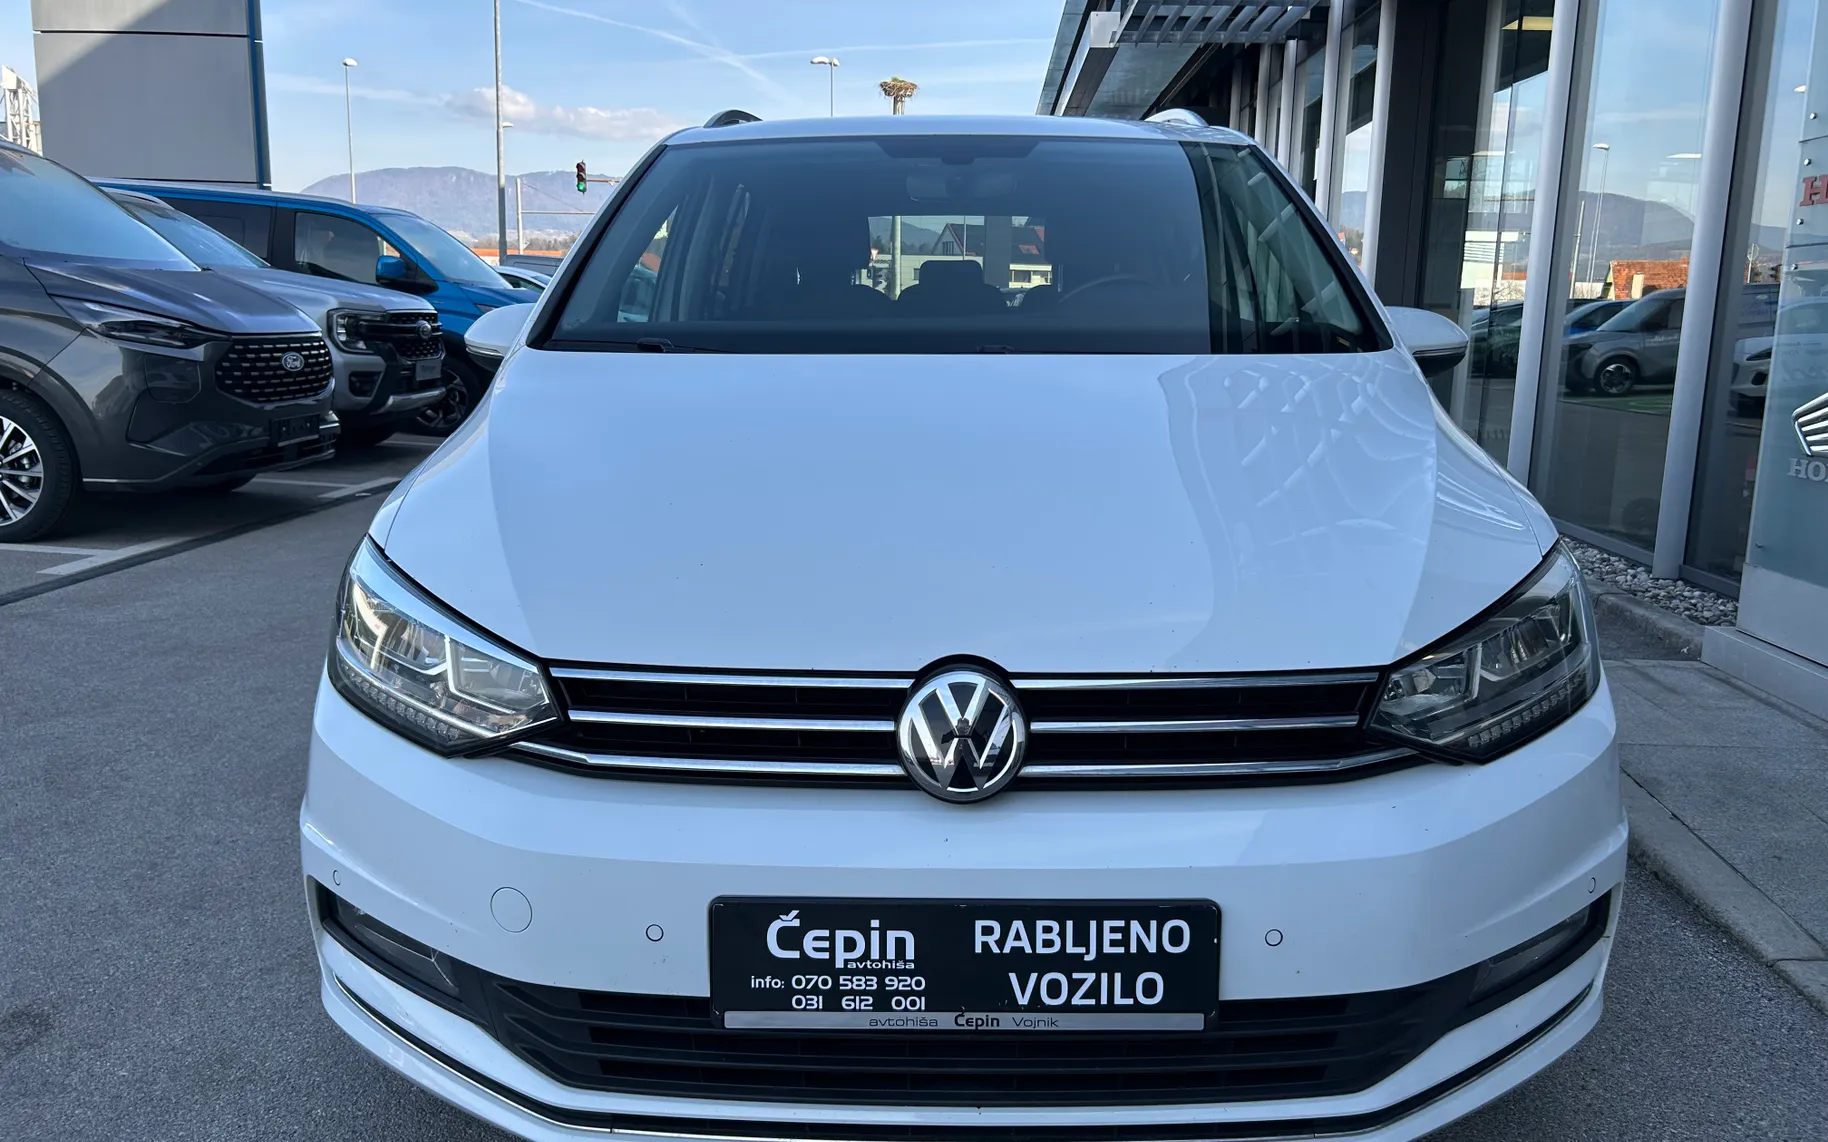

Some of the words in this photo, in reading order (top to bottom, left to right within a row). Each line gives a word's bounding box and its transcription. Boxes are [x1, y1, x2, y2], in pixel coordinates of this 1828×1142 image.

[1787, 457, 1828, 482] HO
[766, 909, 915, 969] Čepin
[974, 919, 1191, 961] RABLJENO
[847, 960, 915, 970] avtohiša
[750, 975, 785, 989] info:
[791, 975, 832, 990] 070
[839, 975, 878, 990] 583
[884, 976, 926, 991] 920
[1008, 971, 1165, 1006] VOZILO
[791, 995, 823, 1010] 031
[841, 996, 873, 1010] 612
[891, 996, 926, 1011] 001
[868, 1016, 938, 1027] avtohiša
[954, 1006, 1000, 1030] Čepin
[1012, 1016, 1059, 1029] Vojnik
